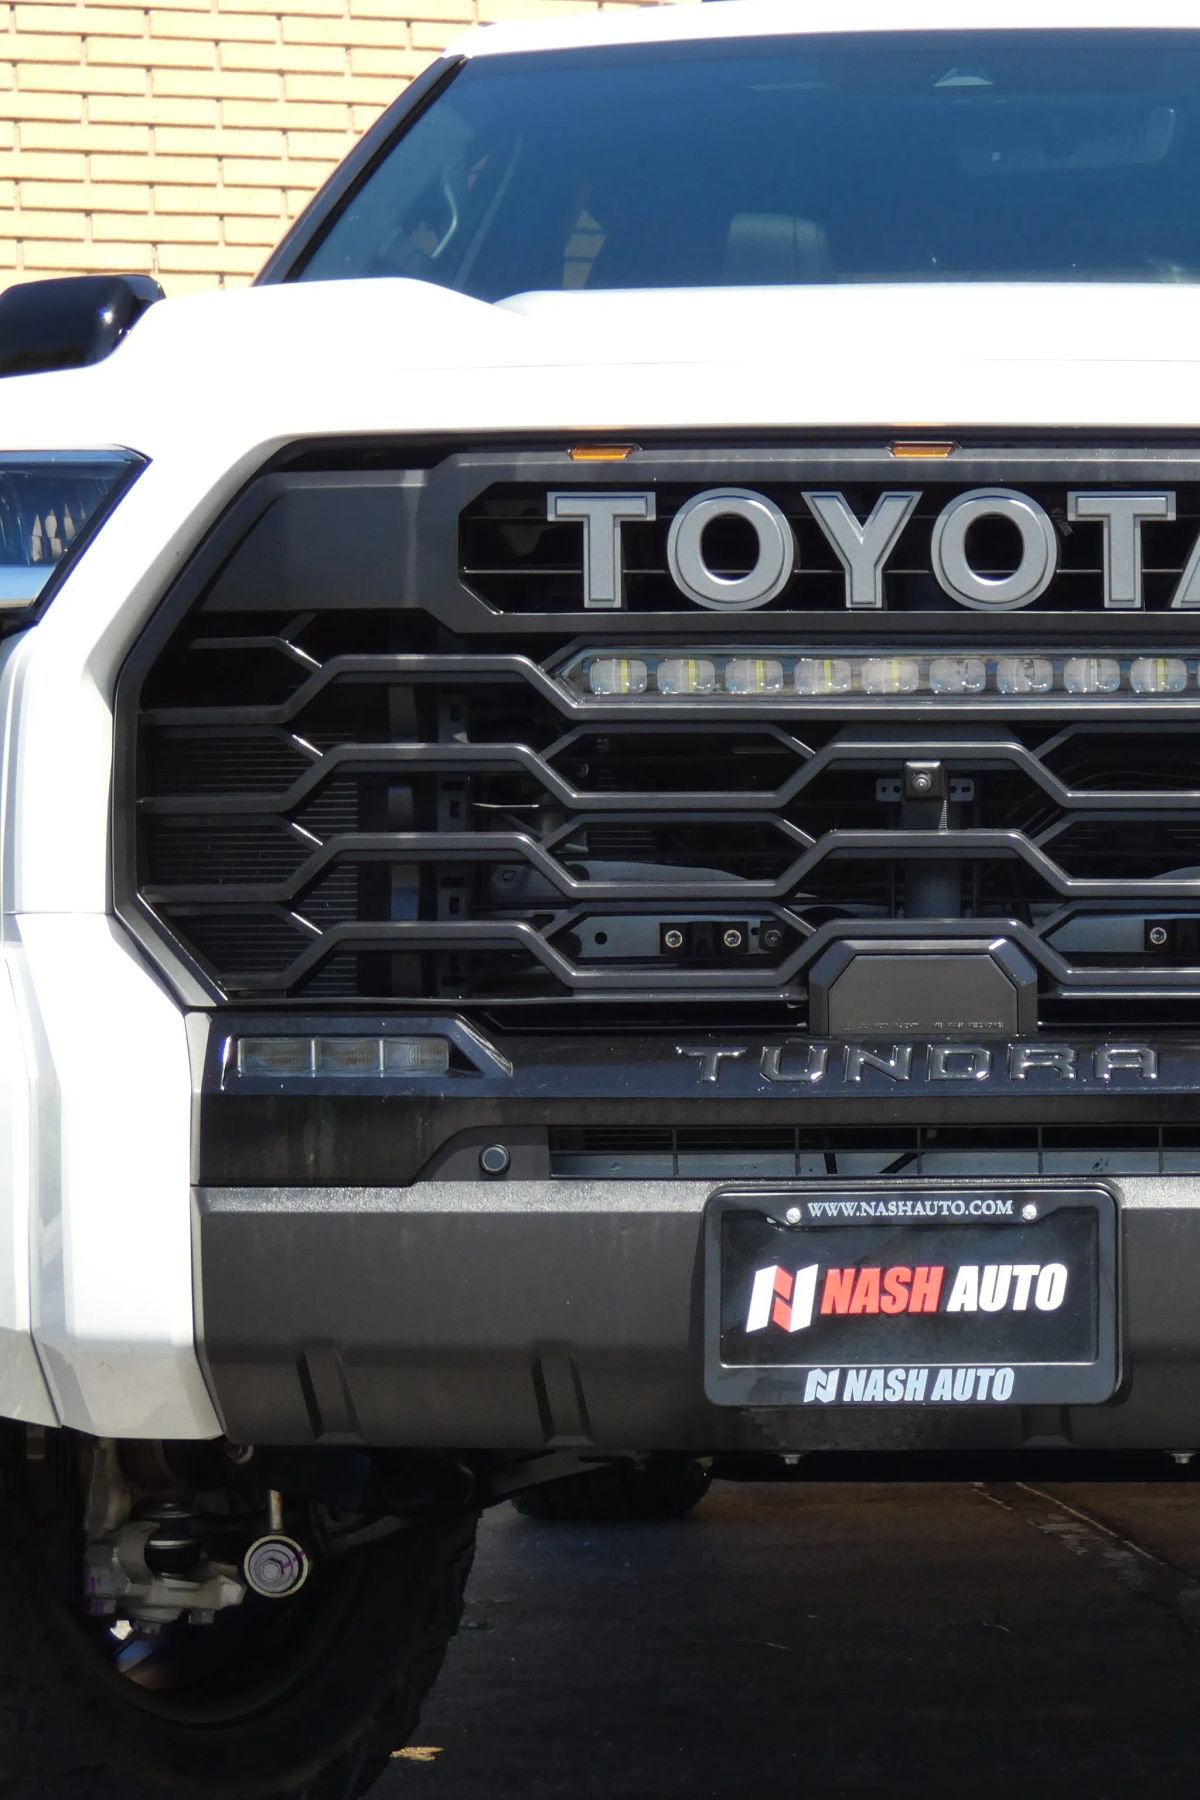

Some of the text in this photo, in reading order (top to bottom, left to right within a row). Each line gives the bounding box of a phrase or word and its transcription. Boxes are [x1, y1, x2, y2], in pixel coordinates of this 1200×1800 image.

[675, 1043, 1160, 1083] TUNDRA
[807, 1200, 1013, 1217] WWW.NASHAUTO.COM
[819, 1265, 945, 1315] NASH
[946, 1263, 1068, 1313] AUTO
[843, 1369, 930, 1401] NASH
[931, 1367, 1015, 1401] AUTO
